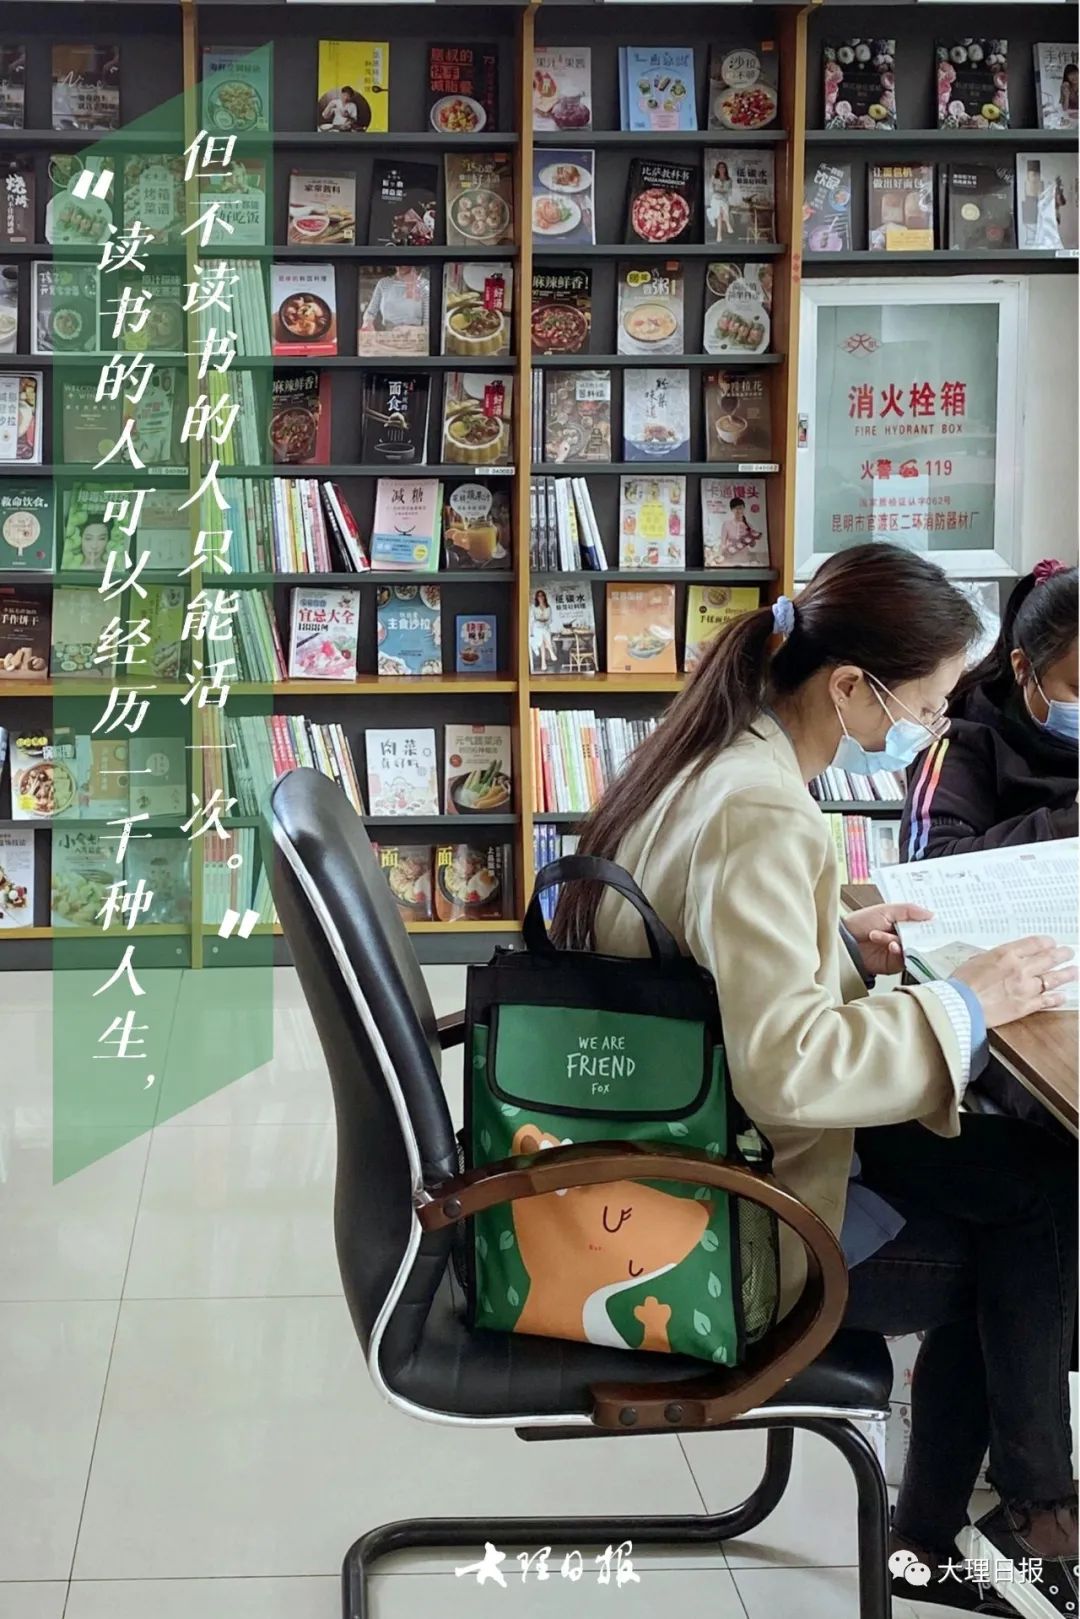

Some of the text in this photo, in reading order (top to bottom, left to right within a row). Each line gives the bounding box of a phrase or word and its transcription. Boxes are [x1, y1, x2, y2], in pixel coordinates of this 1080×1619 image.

[848, 381, 967, 419] 消火栓箱
[855, 423, 963, 437] FIRE HYDRANT BOX
[861, 460, 953, 480] 火警 119
[832, 511, 980, 533] 昆明市官渡区二环消防器材厂
[299, 608, 355, 625] 宜忌大全
[578, 1036, 625, 1050] WE ARE
[567, 1053, 636, 1079] FRIEND
